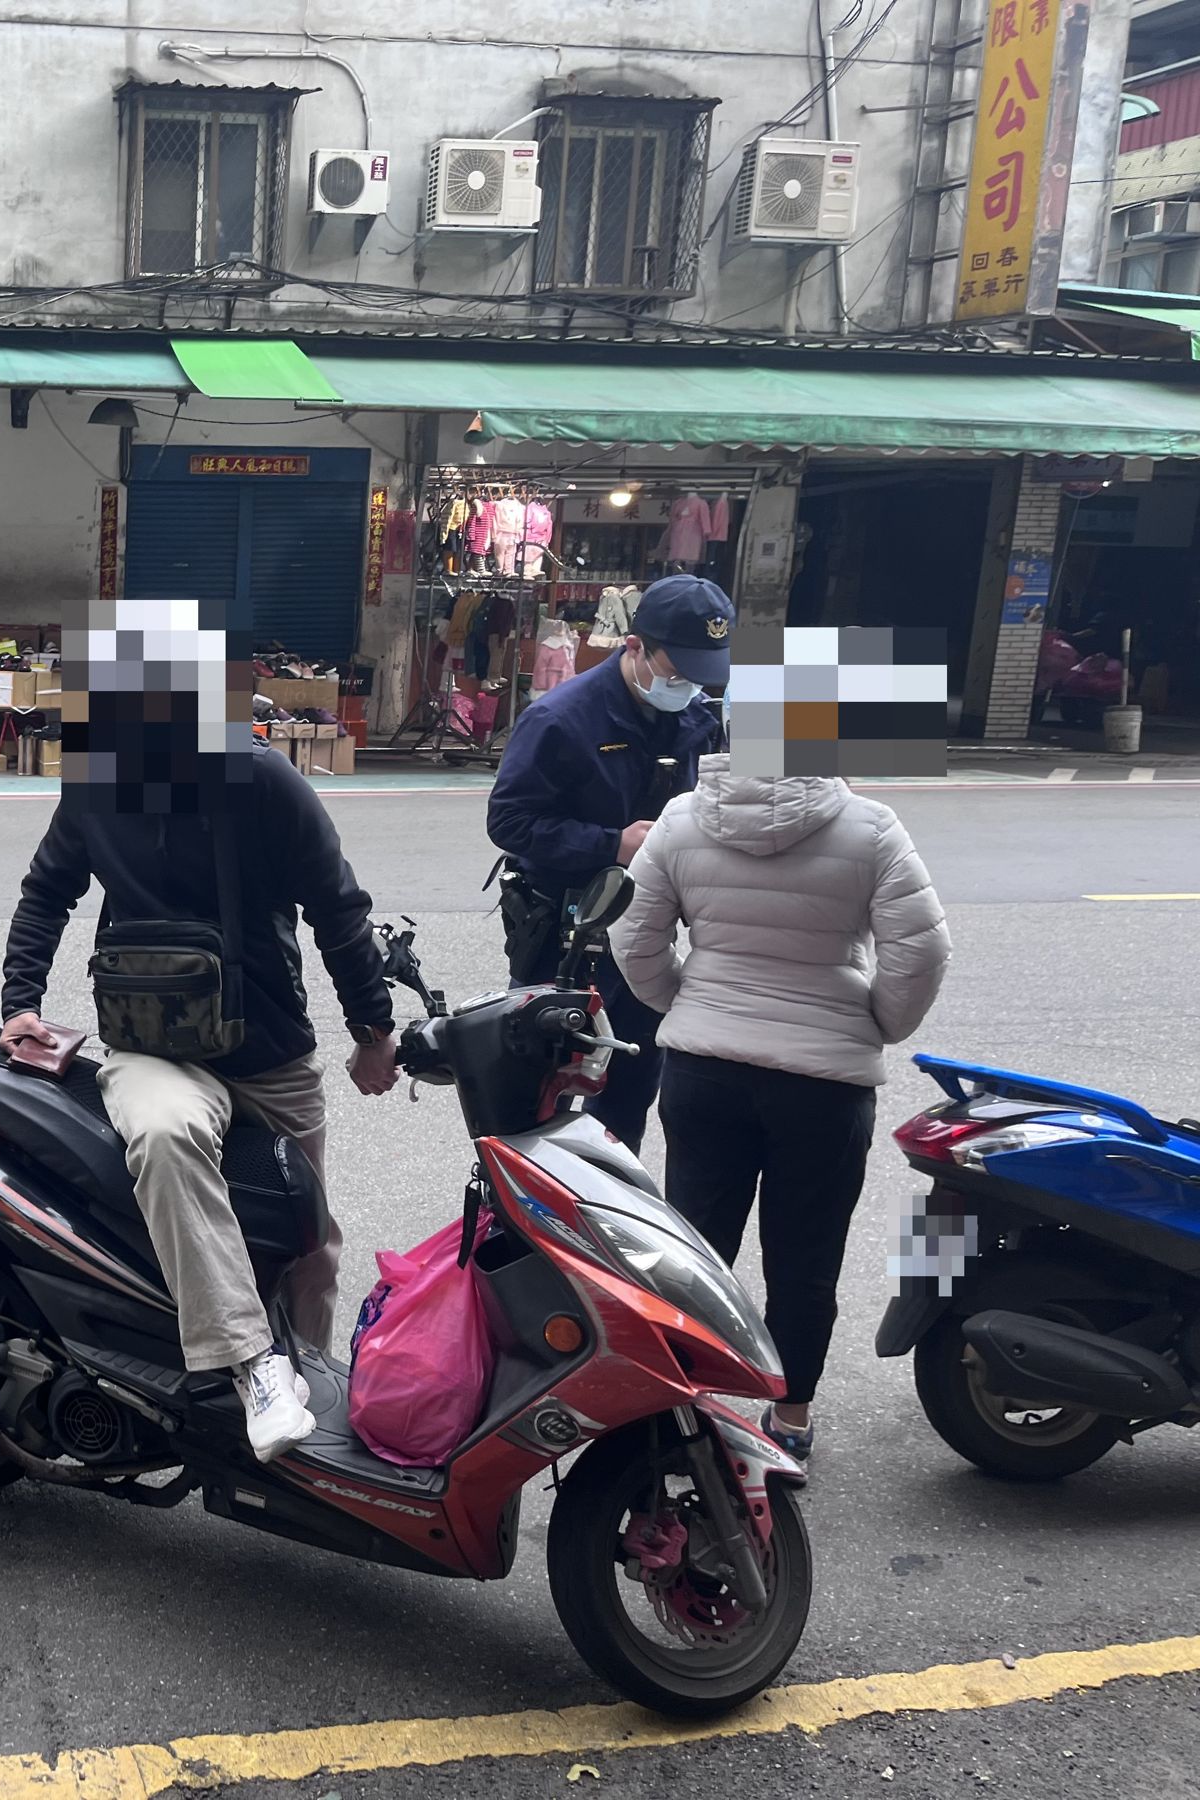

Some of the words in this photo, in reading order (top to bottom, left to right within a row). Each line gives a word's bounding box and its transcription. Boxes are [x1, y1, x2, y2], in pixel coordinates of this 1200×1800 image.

[983, 57, 1040, 232] 公司
[971, 247, 1019, 271] 回春
[313, 1478, 374, 1504] SPECIAL
[373, 1498, 437, 1519] EDITION
